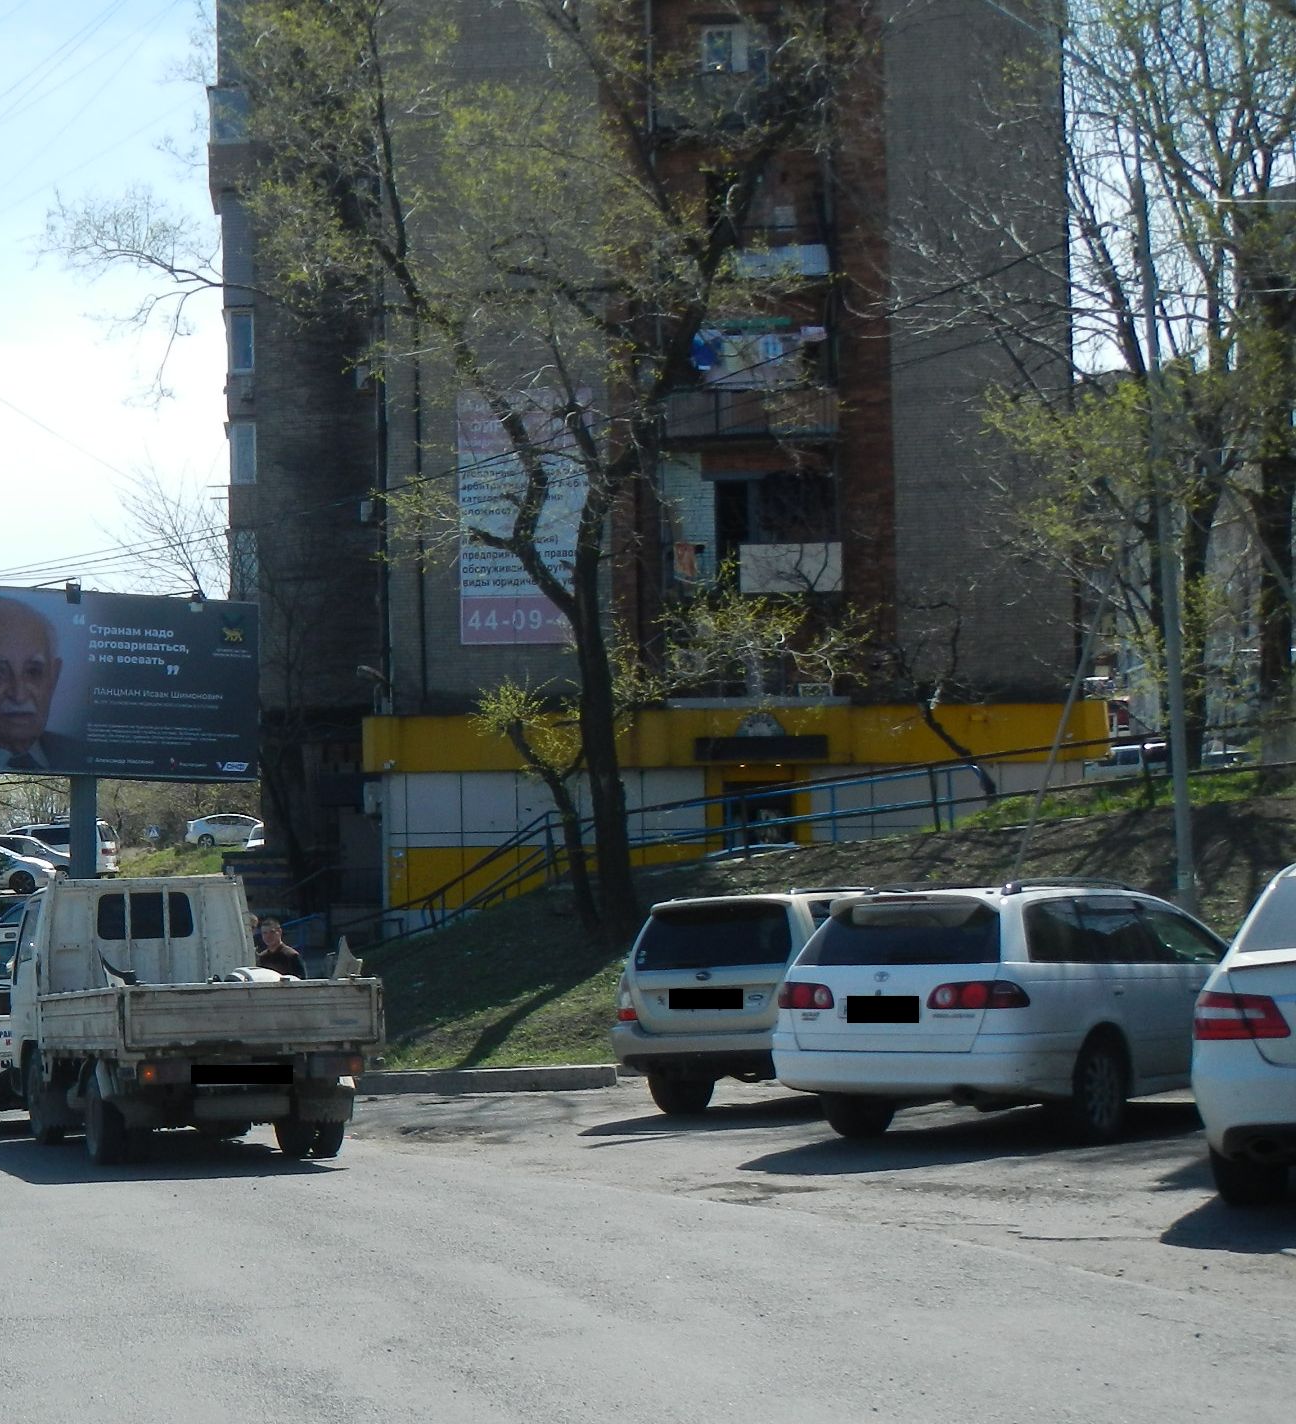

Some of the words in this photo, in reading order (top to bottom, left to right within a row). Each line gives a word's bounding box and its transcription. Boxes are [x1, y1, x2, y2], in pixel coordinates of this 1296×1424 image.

[462, 579, 490, 587] виды
[89, 624, 141, 637] Странам
[144, 629, 174, 639] надо
[88, 640, 190, 655] договариваться,
[99, 654, 114, 663] не
[116, 655, 165, 665] воевать
